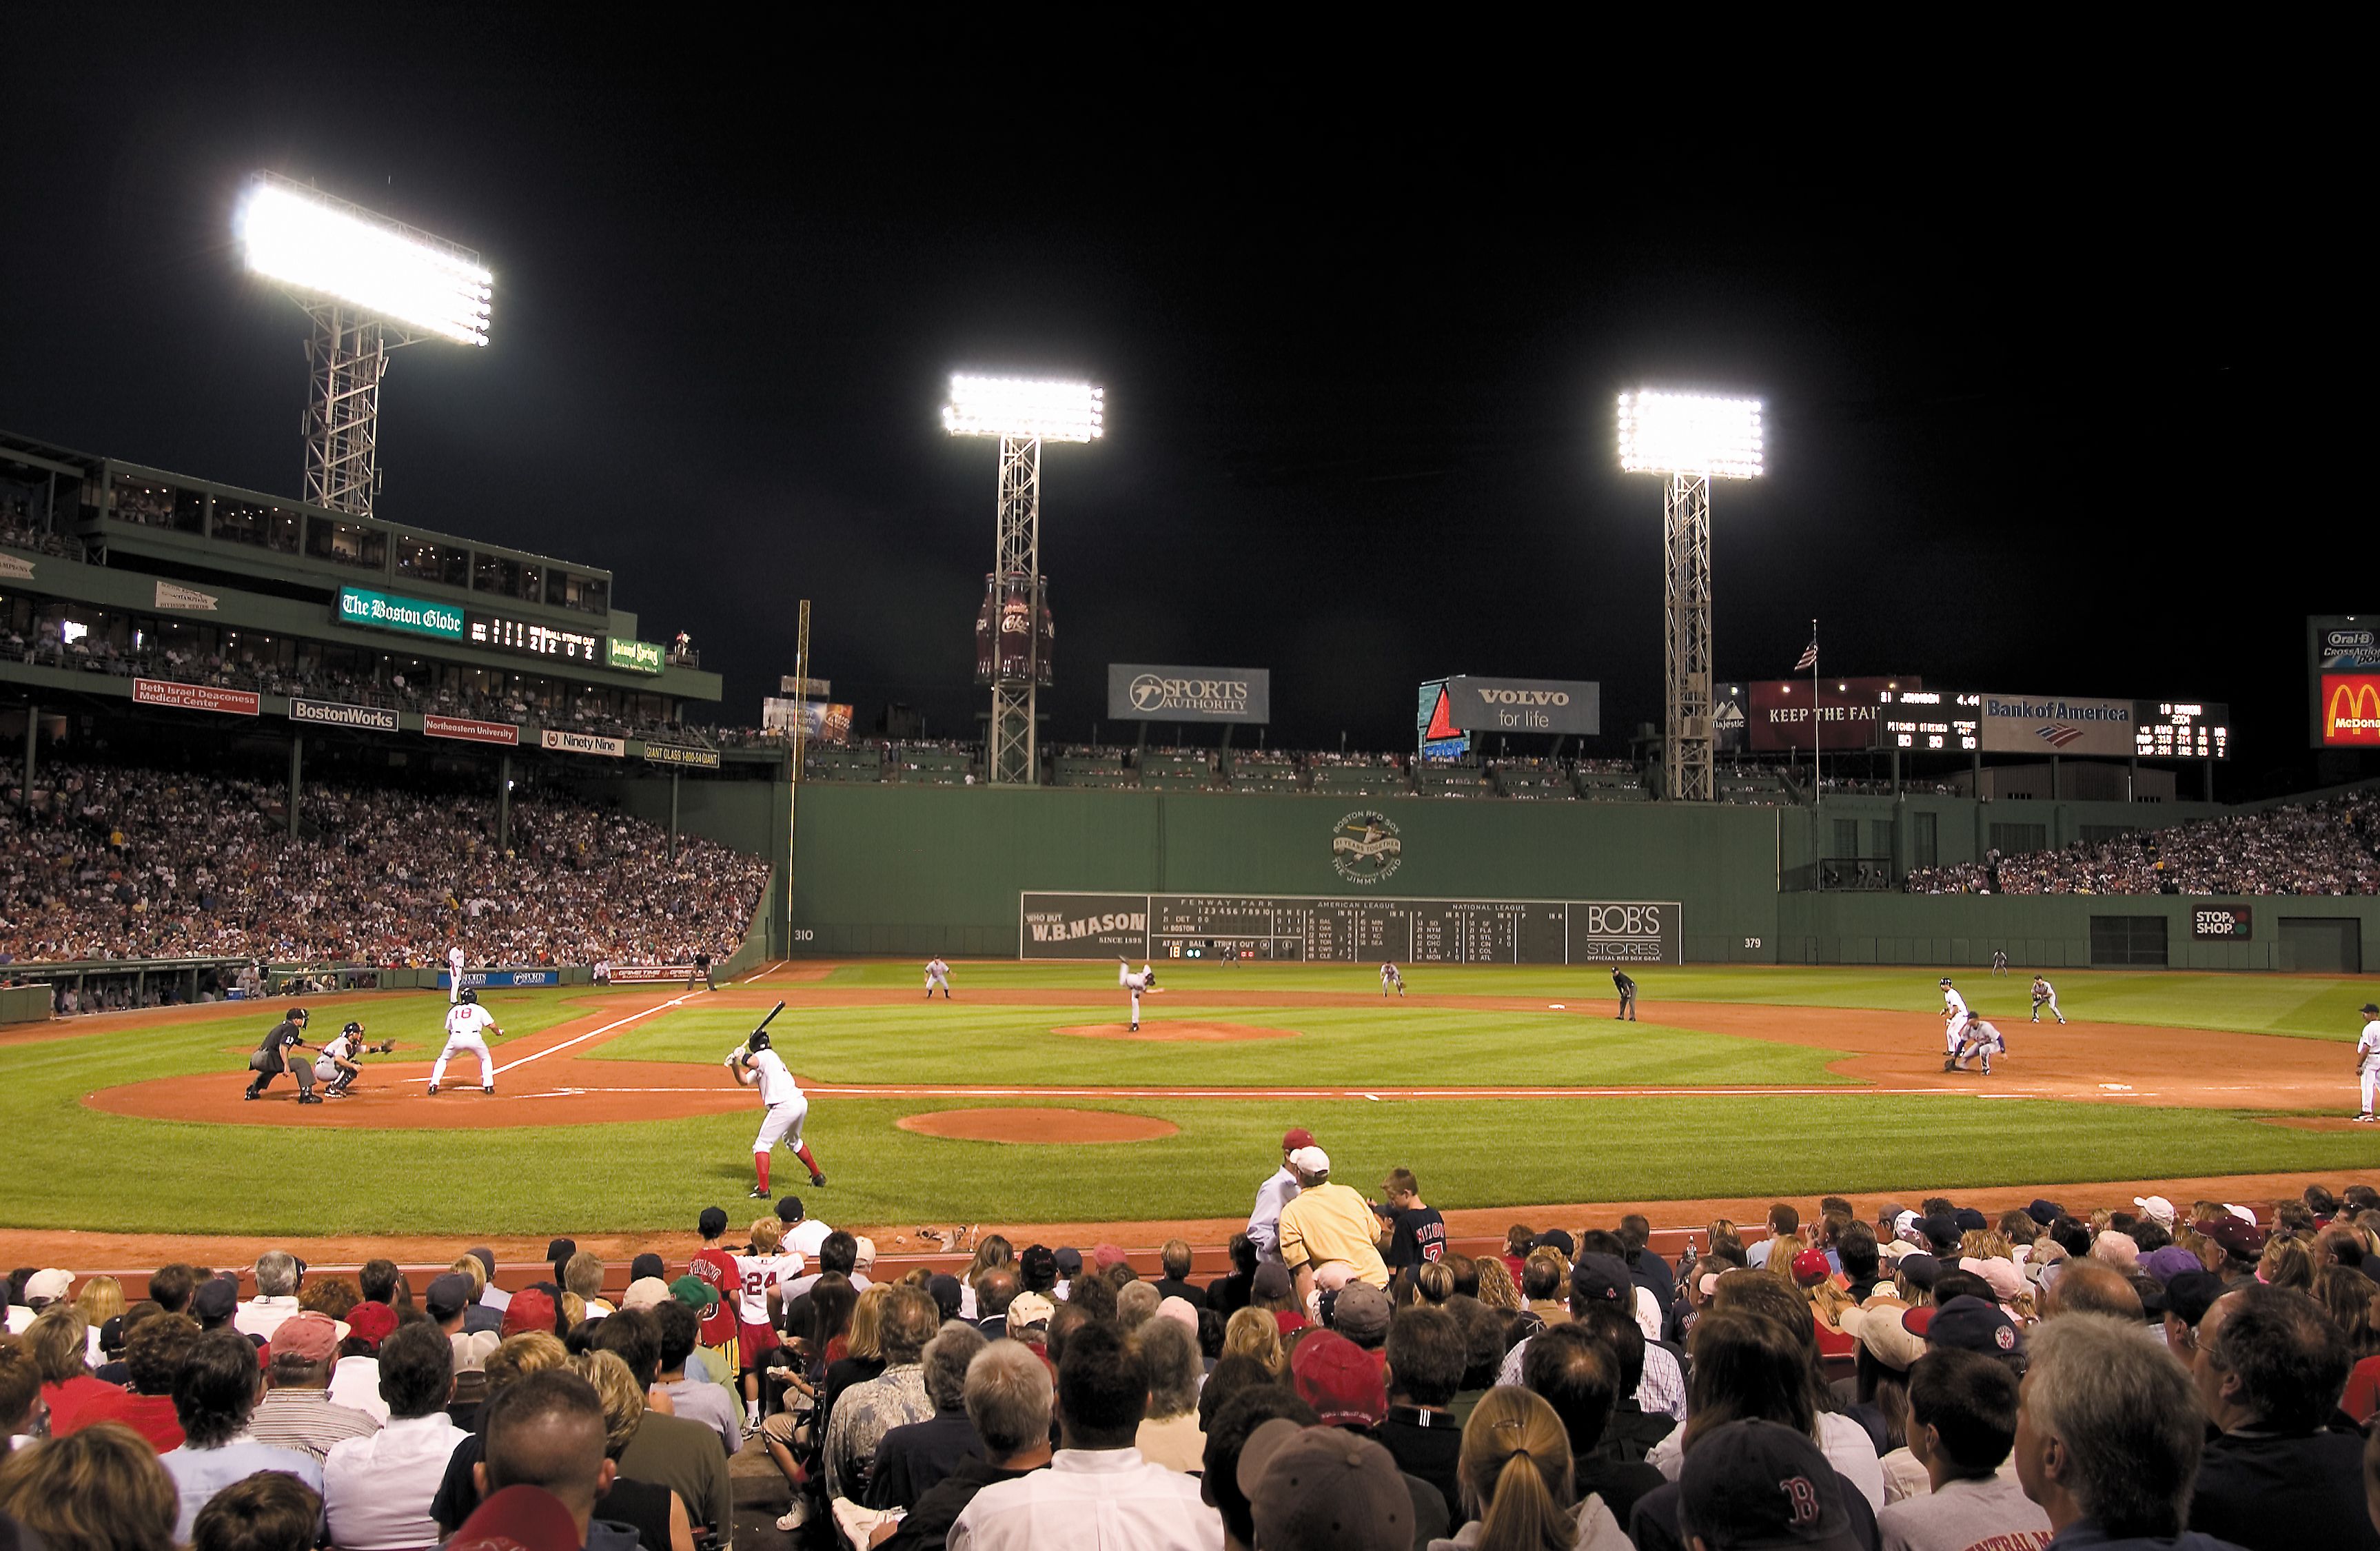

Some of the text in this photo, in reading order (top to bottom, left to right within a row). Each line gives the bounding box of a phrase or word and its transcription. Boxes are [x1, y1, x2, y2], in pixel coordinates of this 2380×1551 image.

[343, 594, 461, 632] The Boston Globe
[2331, 633, 2370, 644] Oral-B
[530, 636, 538, 651] 2
[549, 640, 556, 653] 2
[567, 642, 575, 657] 0
[584, 645, 593, 660] 2
[636, 643, 658, 666] Spring
[140, 682, 255, 704] Beth Israel Deaconess
[1163, 678, 1248, 700] SPORTS
[1478, 689, 1569, 707] VOLVO
[139, 691, 219, 708] Medical Center
[1163, 698, 1246, 710] AUTHORITY
[296, 701, 394, 727] BostonWorks
[1499, 709, 1550, 728] for life
[1769, 706, 1881, 723] KEEP THE FAI
[1986, 699, 2129, 722] Bank of America
[2171, 714, 2190, 725] 2004
[427, 720, 513, 740] Northeastern University
[563, 733, 616, 751] Ninety Nine
[646, 746, 662, 758] GIANT
[663, 748, 681, 761] GLASS
[702, 753, 718, 764] GIANT
[1333, 810, 1401, 835] BOSTON RED SOX
[1367, 841, 1399, 852] TOGETHER
[1346, 875, 1377, 885] JIMMY
[1381, 859, 1401, 881] FUND
[1026, 913, 1063, 922] WHO BUT
[1588, 906, 1660, 935] BOB'S
[2196, 911, 2230, 922] STOP
[795, 929, 813, 941] 310
[2197, 922, 2232, 934] SHOP
[1098, 936, 1123, 944] SINCE
[1587, 942, 1660, 955] STORES
[1745, 937, 1761, 949] 379
[1169, 946, 1181, 958] 18
[455, 1007, 472, 1020] 18
[1416, 1222, 1445, 1244] NIXON
[1423, 1241, 1444, 1264] 7
[746, 1271, 777, 1296] 24
[1779, 1476, 1819, 1525] B
